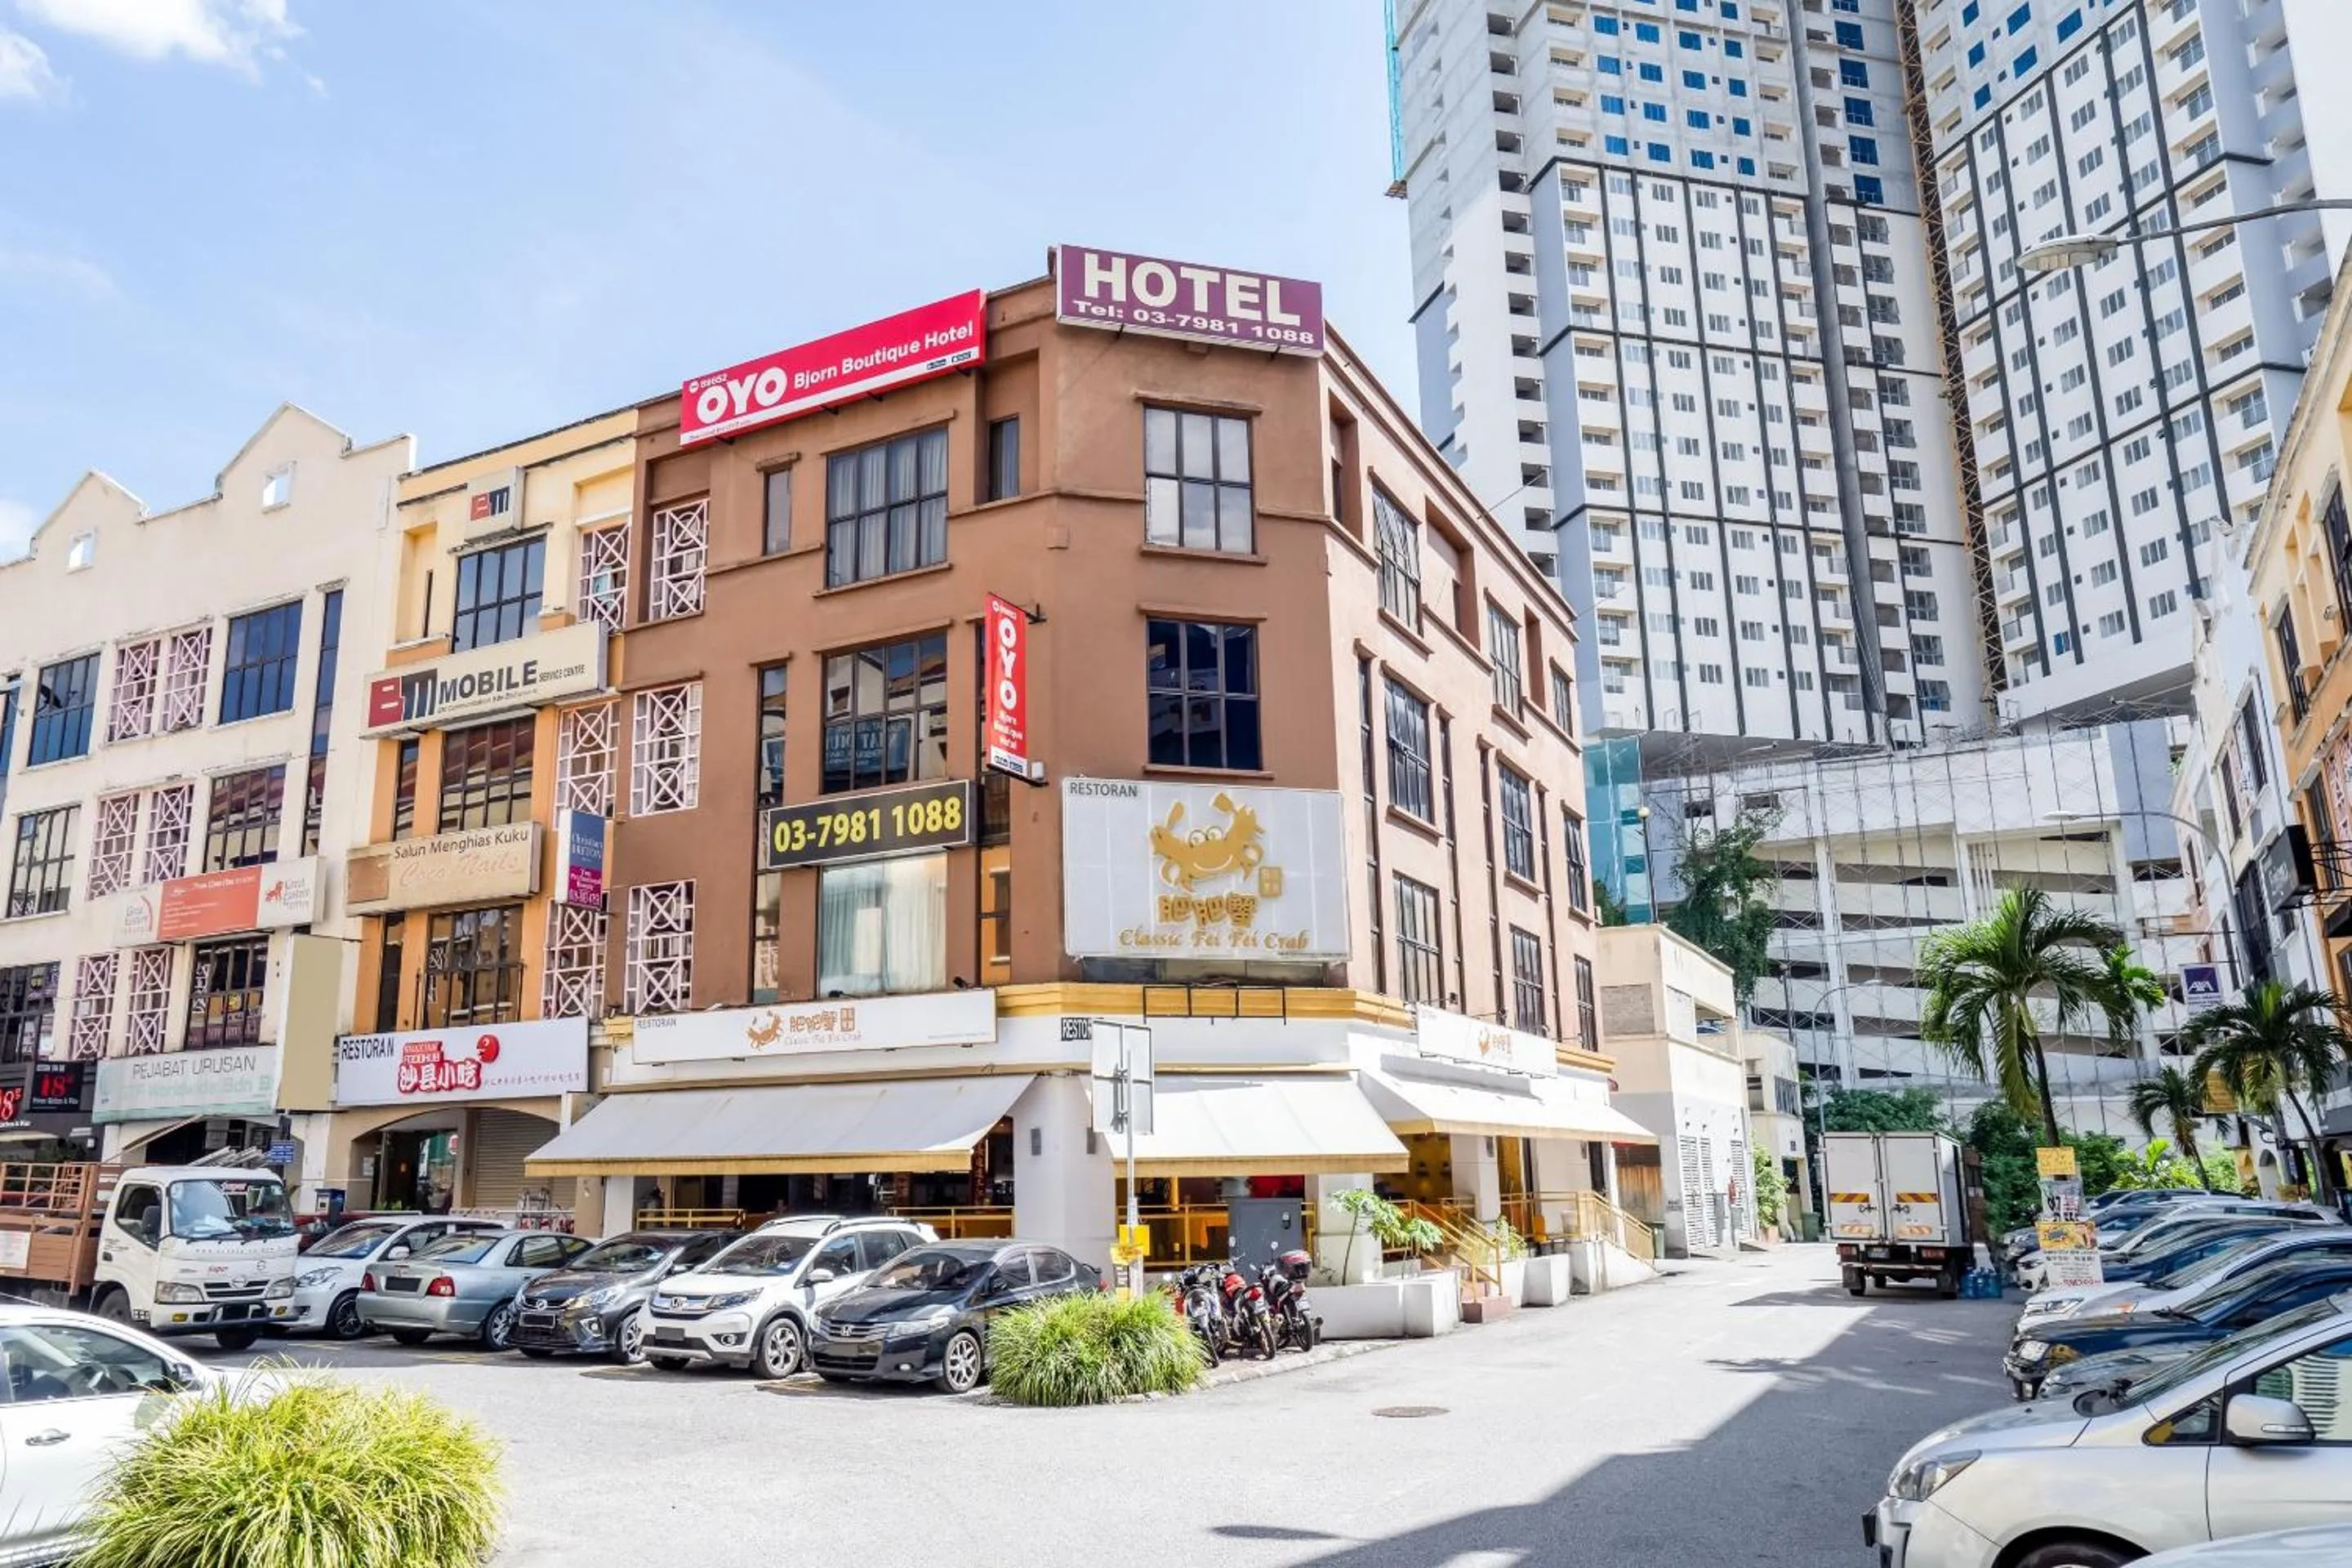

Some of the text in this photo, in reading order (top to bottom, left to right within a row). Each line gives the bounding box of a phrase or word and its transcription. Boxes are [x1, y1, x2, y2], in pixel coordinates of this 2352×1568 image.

[1085, 252, 1301, 327] HOTEL
[1072, 300, 1314, 345] Tel: 03-7981 1088
[696, 367, 788, 425] OYO
[794, 365, 838, 390] Bjorn
[841, 339, 920, 375] Boutique
[924, 320, 973, 350] Hotel
[998, 617, 1018, 710] OYO
[439, 660, 538, 705] MOBILE
[1070, 782, 1138, 798] RESTORAN
[774, 796, 961, 853] 03-7981 1088
[394, 830, 528, 860] Salun Menghias Kuku
[1119, 928, 1183, 947] Classic
[1191, 929, 1221, 947] Fei
[1265, 929, 1310, 950] Crab
[2188, 981, 2214, 992] AXA
[341, 1037, 394, 1060] RESTORAN
[132, 1055, 256, 1080] PEJABAT URUSAN
